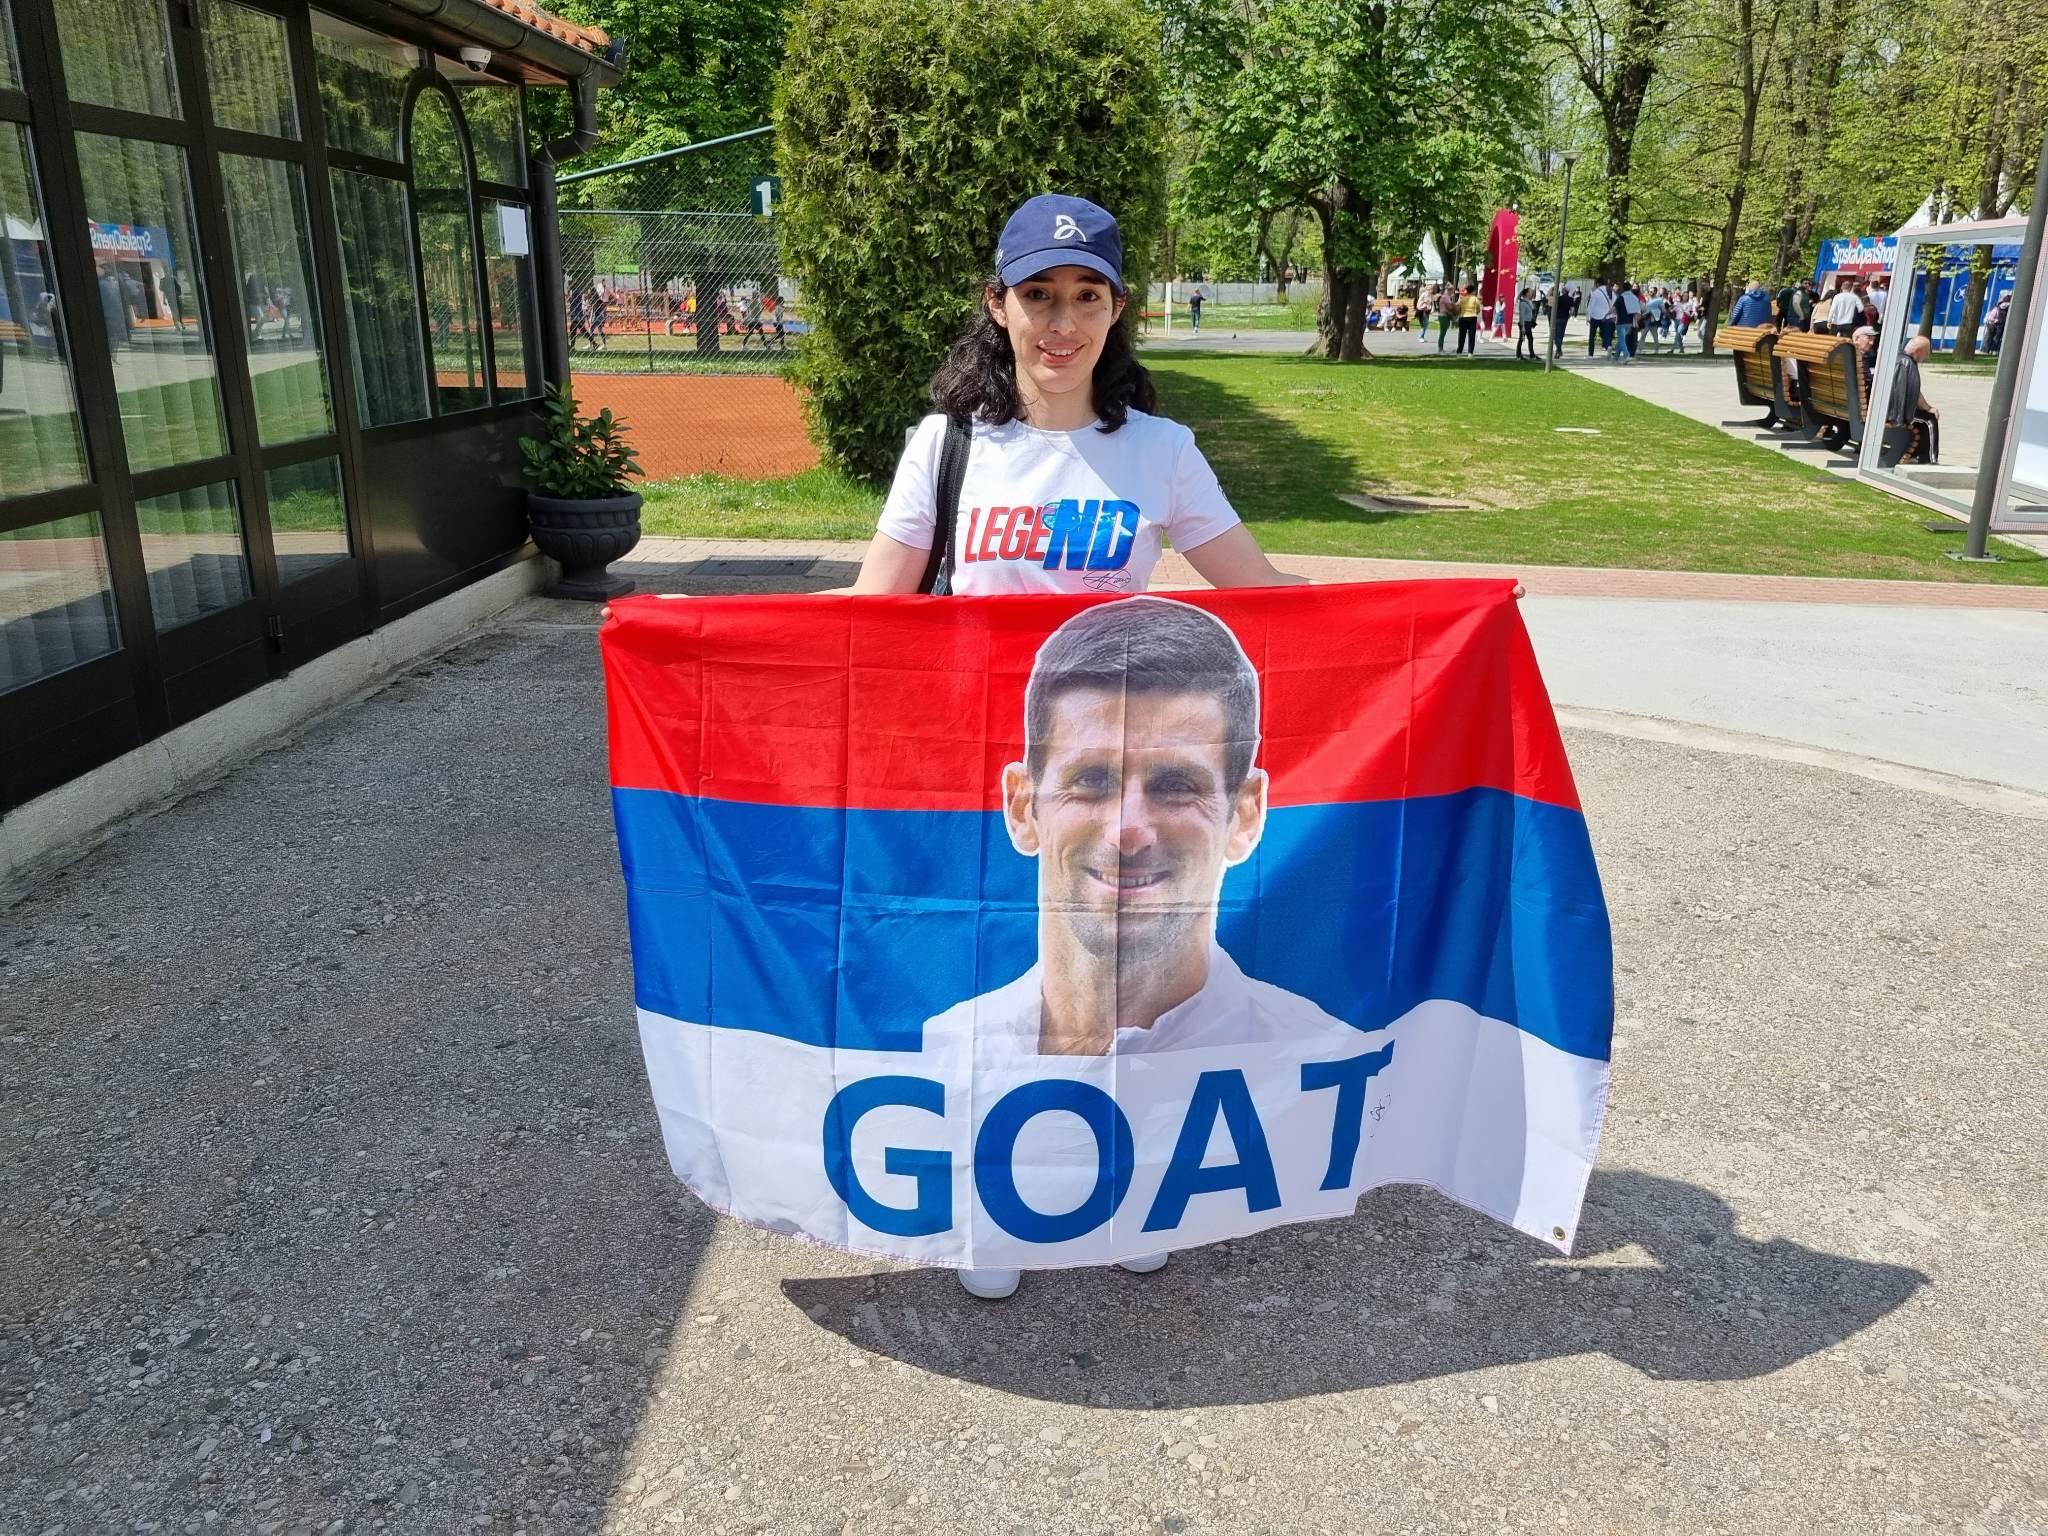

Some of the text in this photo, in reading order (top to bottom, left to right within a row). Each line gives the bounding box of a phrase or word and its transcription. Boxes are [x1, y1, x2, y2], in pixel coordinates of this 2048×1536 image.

[756, 181, 772, 216] 1
[964, 499, 1141, 571] LEGEND
[822, 1039, 1395, 1244] GOAT
